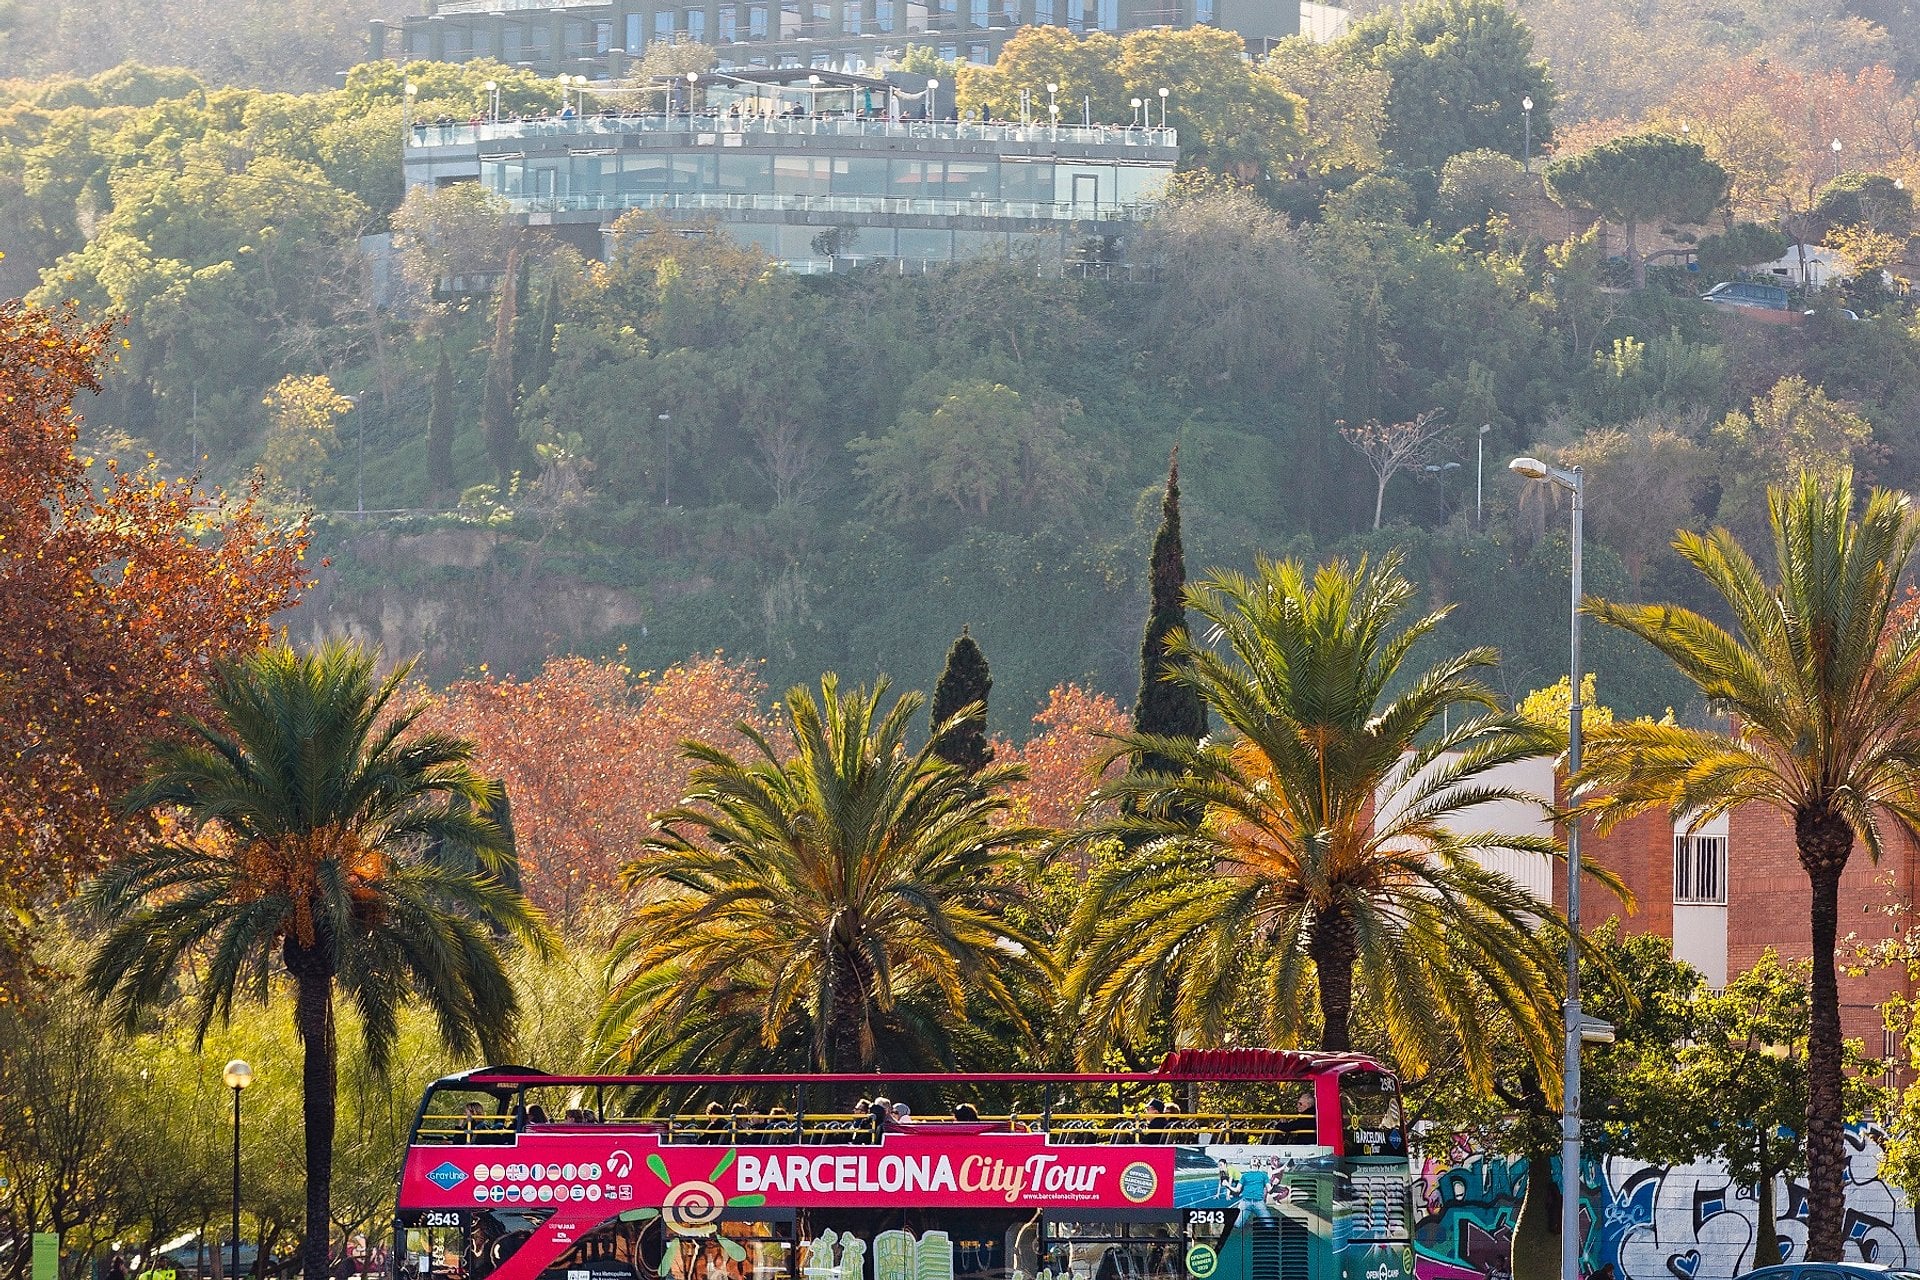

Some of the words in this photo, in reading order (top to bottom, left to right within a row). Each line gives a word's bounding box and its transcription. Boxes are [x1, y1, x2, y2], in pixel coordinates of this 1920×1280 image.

[1355, 1131, 1387, 1144] BARCELONA
[737, 1154, 959, 1193] BARCELONA
[958, 1154, 1027, 1203] City
[1023, 1154, 1105, 1192] Tour
[1022, 1193, 1100, 1202] www.barcelonacitytour.es
[427, 1212, 460, 1226] 2543
[1189, 1210, 1225, 1224] 2543
